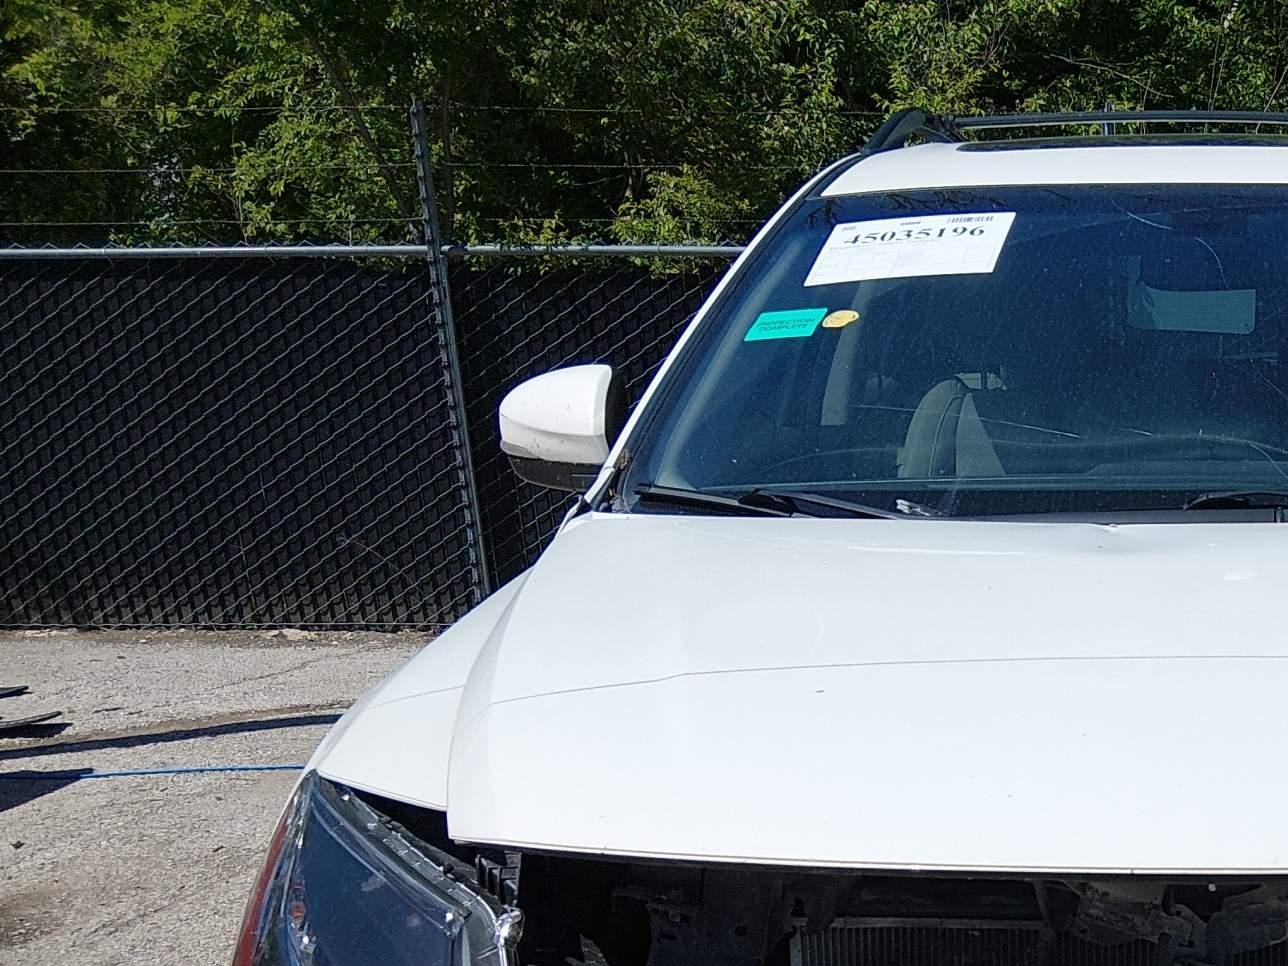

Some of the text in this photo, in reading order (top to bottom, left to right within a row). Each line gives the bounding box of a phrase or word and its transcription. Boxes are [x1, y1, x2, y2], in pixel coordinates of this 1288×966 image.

[844, 225, 985, 244] 45035196
[759, 318, 816, 326] INSPECTION
[758, 323, 807, 332] COMPLETE
